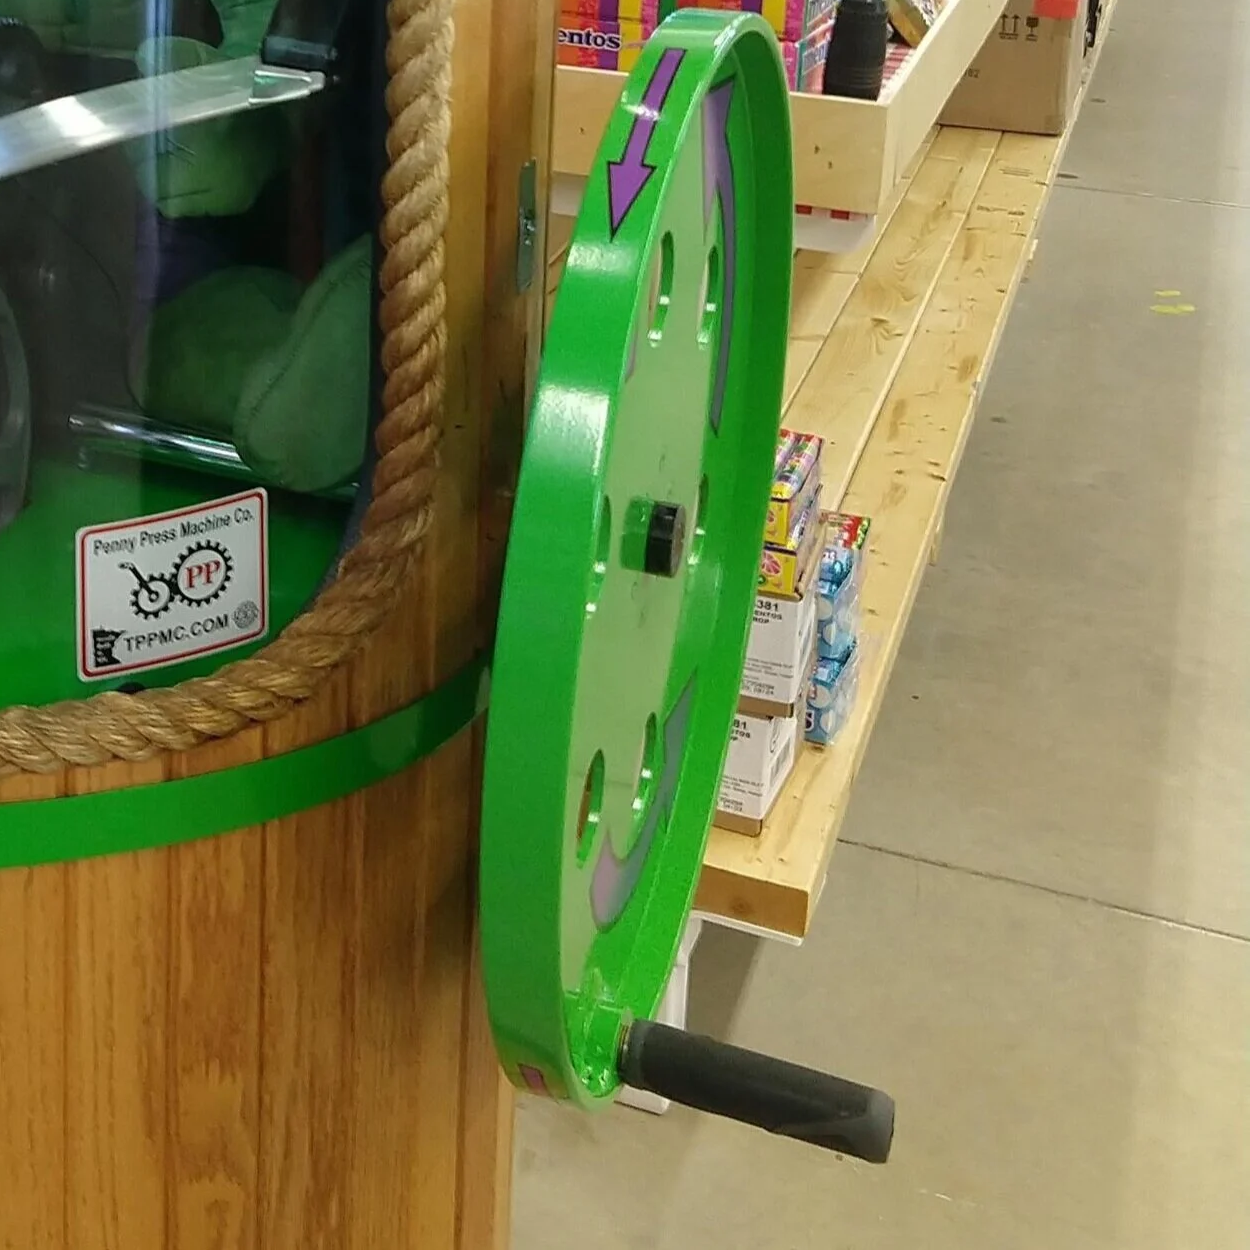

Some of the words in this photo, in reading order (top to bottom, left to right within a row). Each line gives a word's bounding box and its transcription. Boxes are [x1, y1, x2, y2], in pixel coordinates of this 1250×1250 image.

[559, 29, 621, 50] entos
[93, 536, 136, 556] Penny
[140, 527, 176, 547] Press
[180, 513, 230, 538] Machine
[234, 507, 254, 522] Co.
[185, 559, 221, 590] PP
[754, 610, 783, 620] ENTOS
[123, 613, 229, 652] TPPMC.COM
